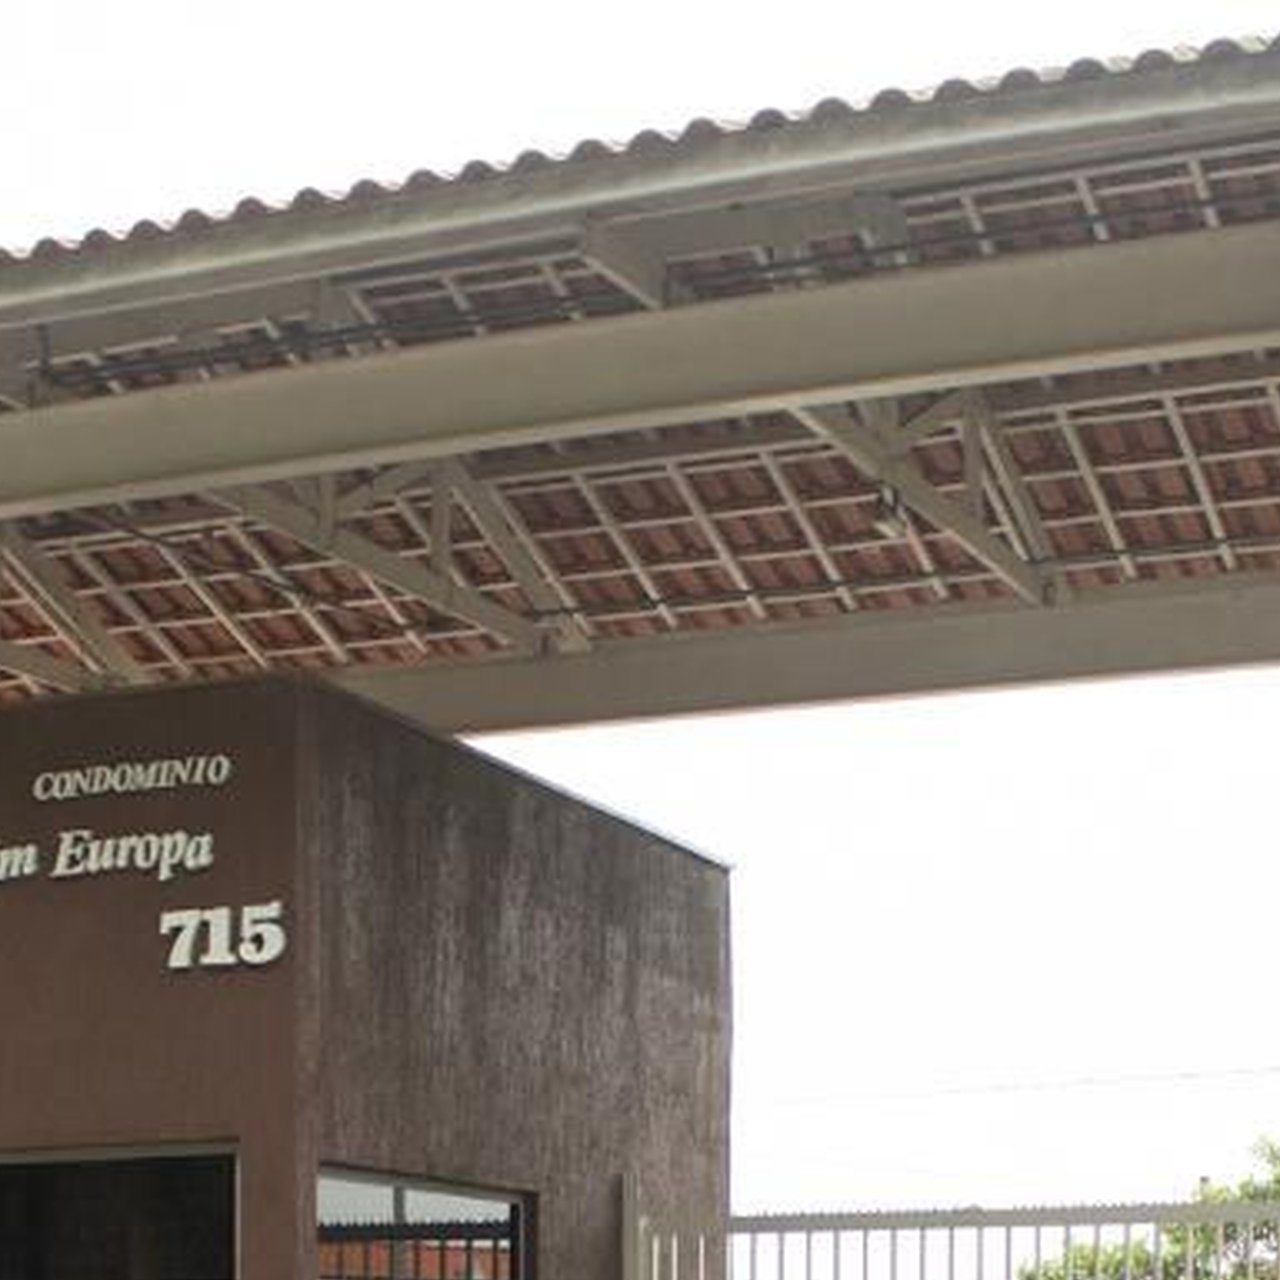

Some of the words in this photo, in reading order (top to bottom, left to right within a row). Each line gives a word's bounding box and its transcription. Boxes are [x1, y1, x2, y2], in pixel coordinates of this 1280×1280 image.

[32, 754, 231, 801] CONDOMINIO
[49, 828, 214, 881] Europa
[159, 900, 288, 969] 715
